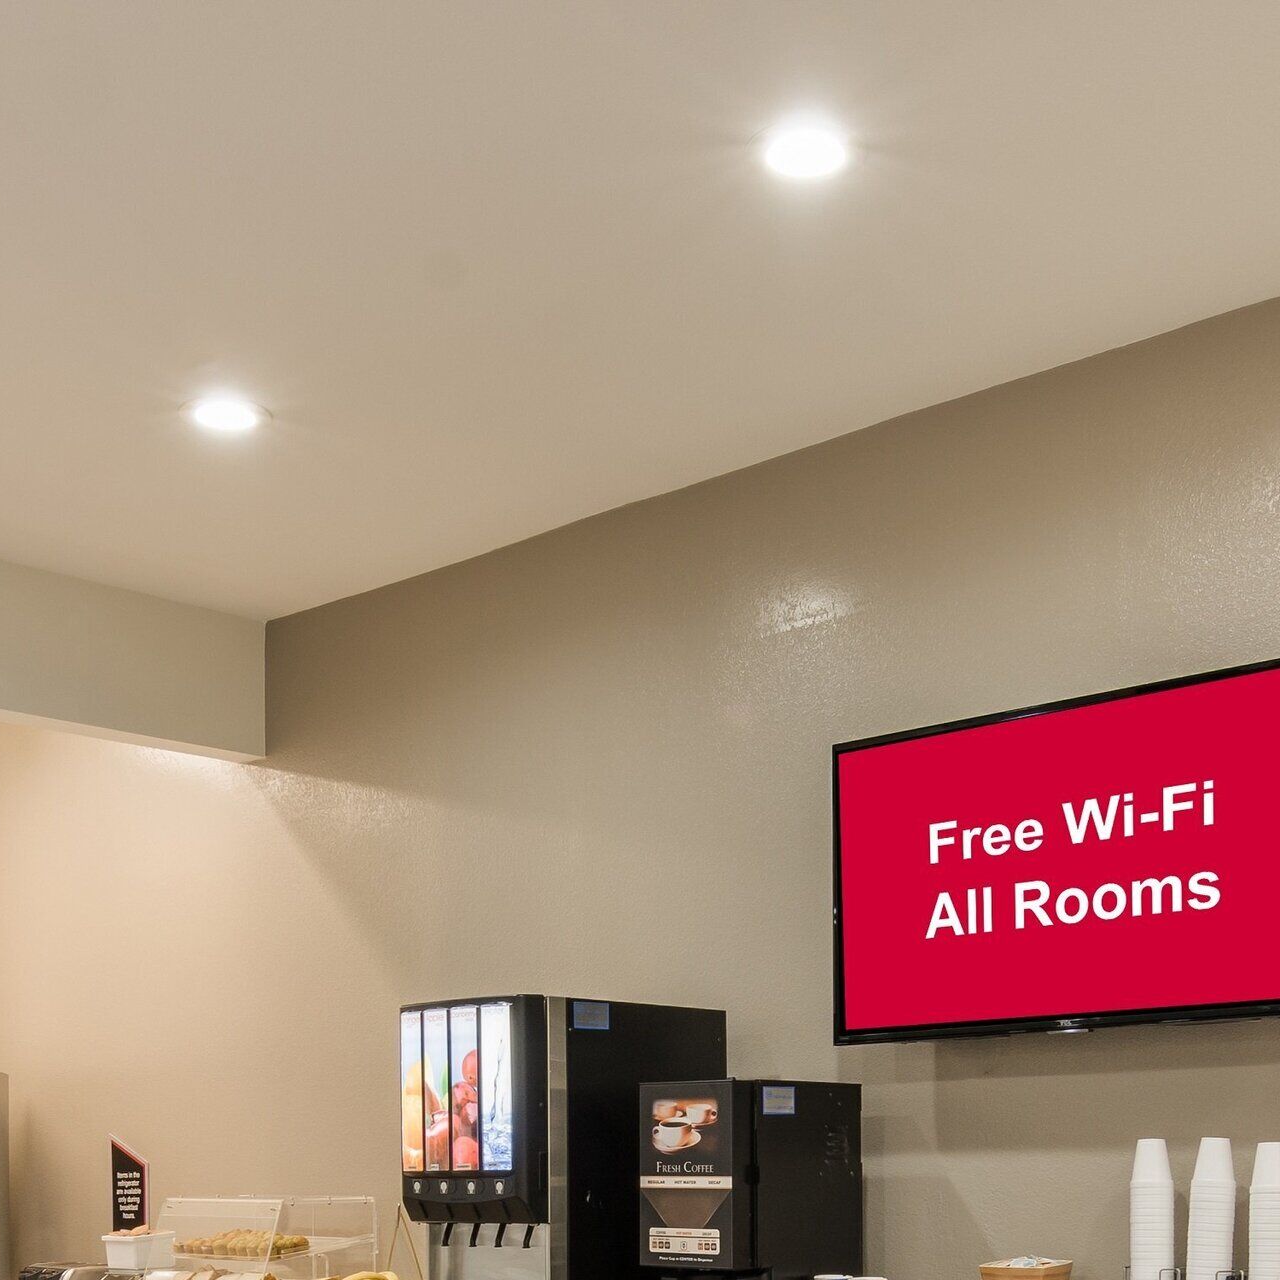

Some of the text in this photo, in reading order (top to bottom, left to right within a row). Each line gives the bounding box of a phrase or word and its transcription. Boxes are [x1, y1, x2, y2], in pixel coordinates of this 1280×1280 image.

[928, 780, 1215, 864] Free Wi-Fi
[925, 870, 1221, 939] All Rooms
[656, 1161, 714, 1173] FRESH COFFEE
